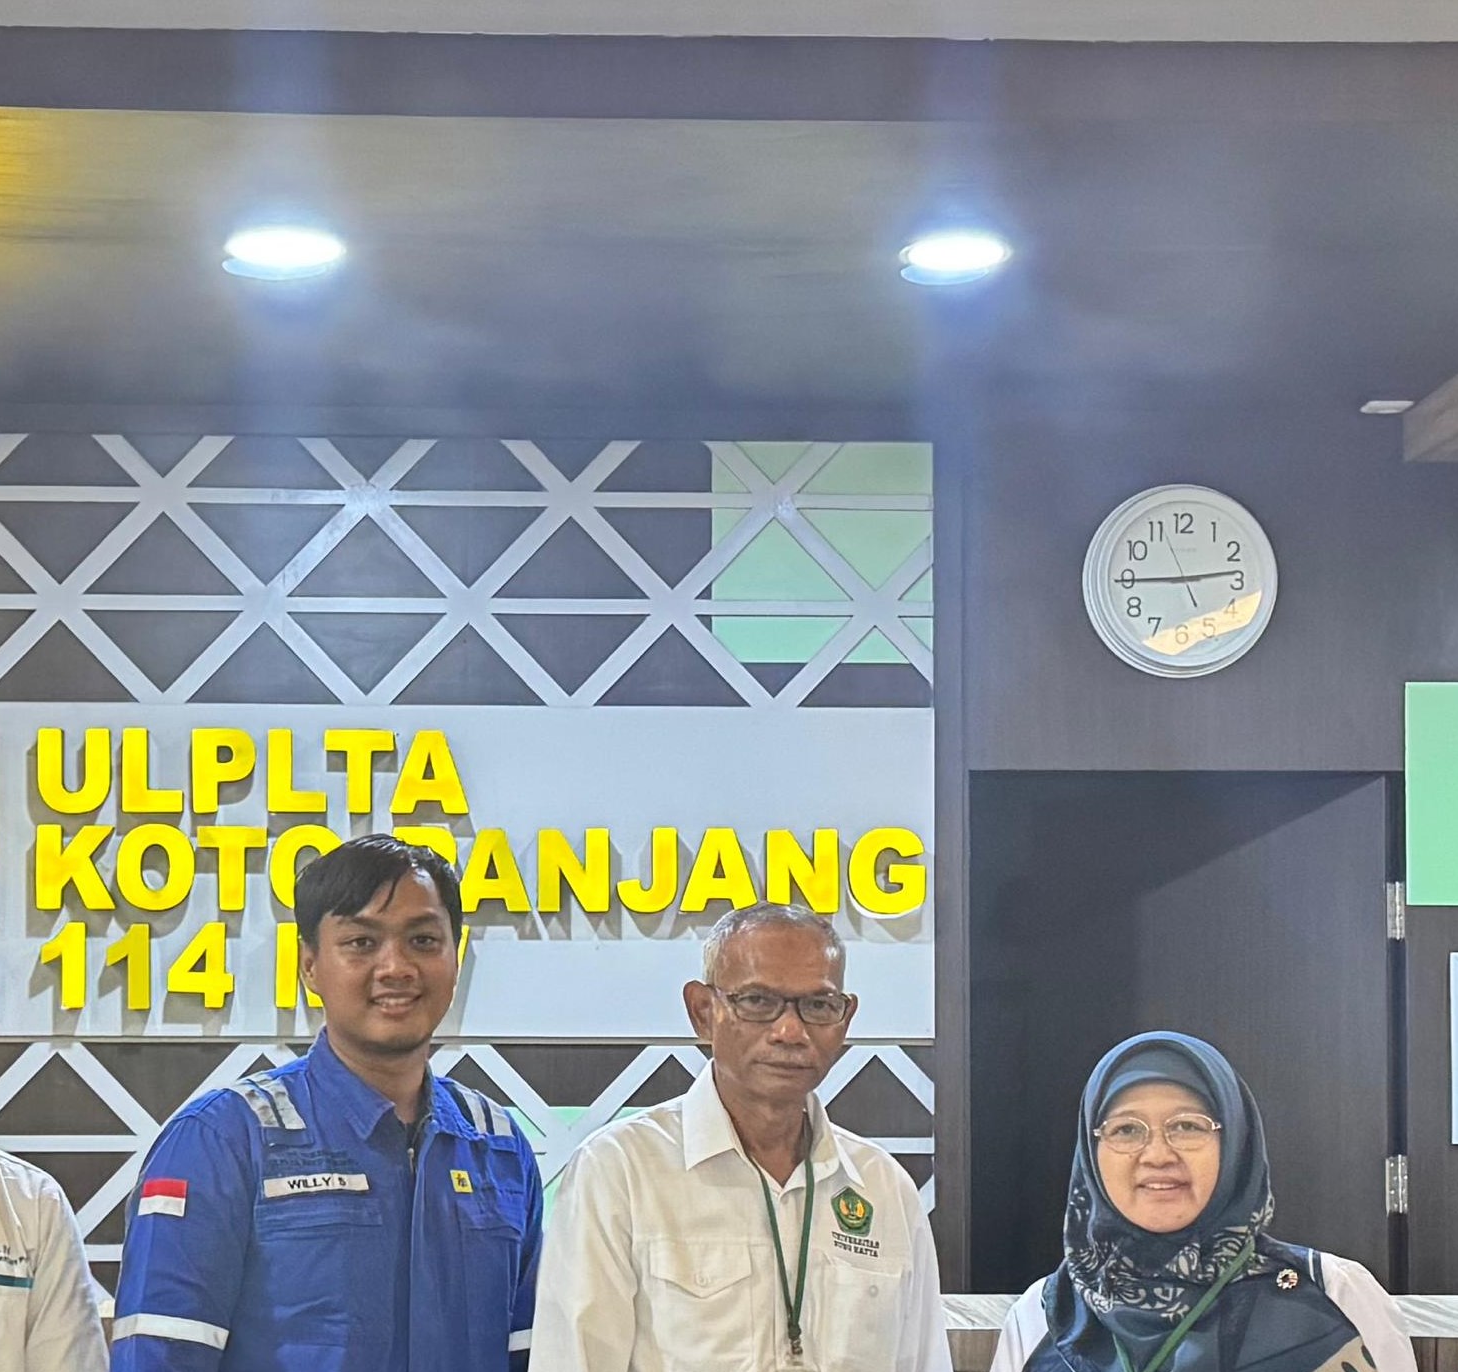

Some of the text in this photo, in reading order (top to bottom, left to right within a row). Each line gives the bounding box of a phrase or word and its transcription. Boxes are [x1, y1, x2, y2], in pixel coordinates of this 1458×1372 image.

[1149, 521, 1164, 542] 11
[1173, 513, 1194, 534] 12
[1211, 521, 1217, 543] 1
[1127, 540, 1148, 561] 10
[1227, 541, 1241, 562] 2
[1120, 569, 1135, 589] 9
[1230, 570, 1244, 590] 3
[1127, 596, 1142, 617] 8
[1223, 598, 1238, 618] 4
[1147, 617, 1162, 637] 7
[1175, 624, 1189, 645] 6
[1202, 618, 1216, 638] 5
[37, 728, 468, 815] ULPLTA
[39, 921, 235, 1011] 114
[287, 1176, 331, 1190] WILLY
